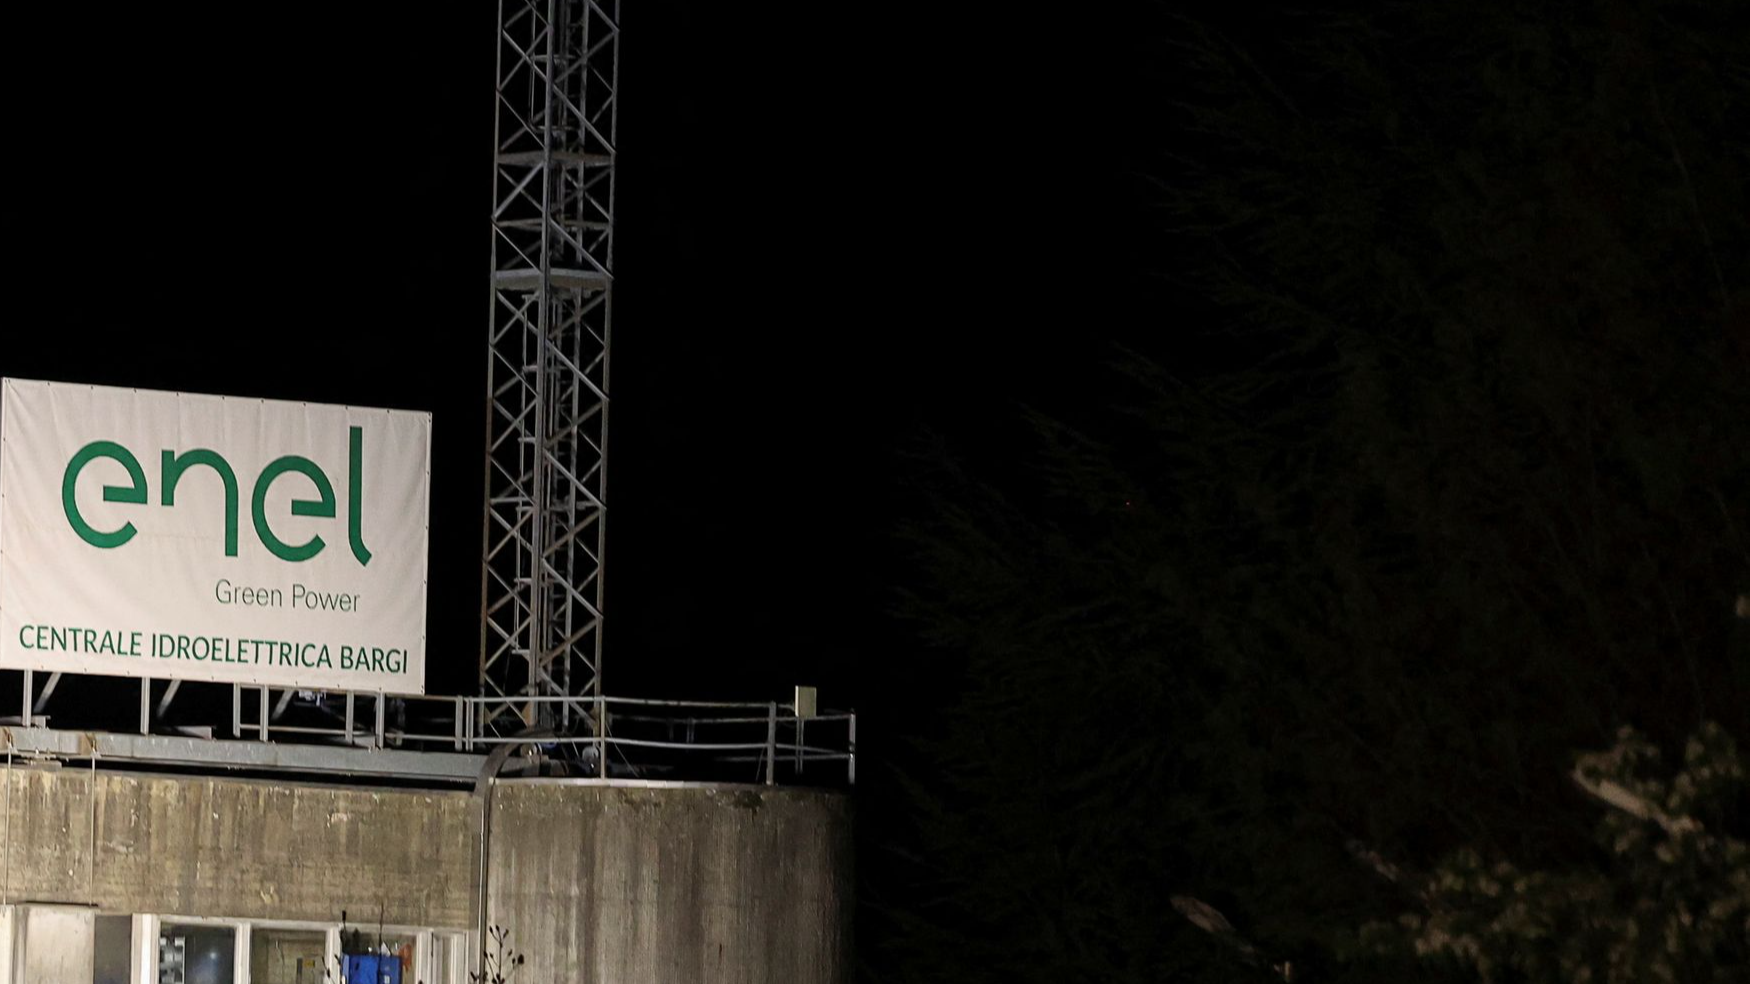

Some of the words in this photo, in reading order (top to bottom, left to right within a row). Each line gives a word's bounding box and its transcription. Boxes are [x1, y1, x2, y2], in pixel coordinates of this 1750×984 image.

[62, 426, 372, 566] enel
[215, 579, 283, 607] Green
[292, 584, 361, 612] Power
[19, 625, 142, 657] CENTRALE
[151, 633, 333, 670] IDROELETTRICA
[340, 646, 408, 674] BARGI
